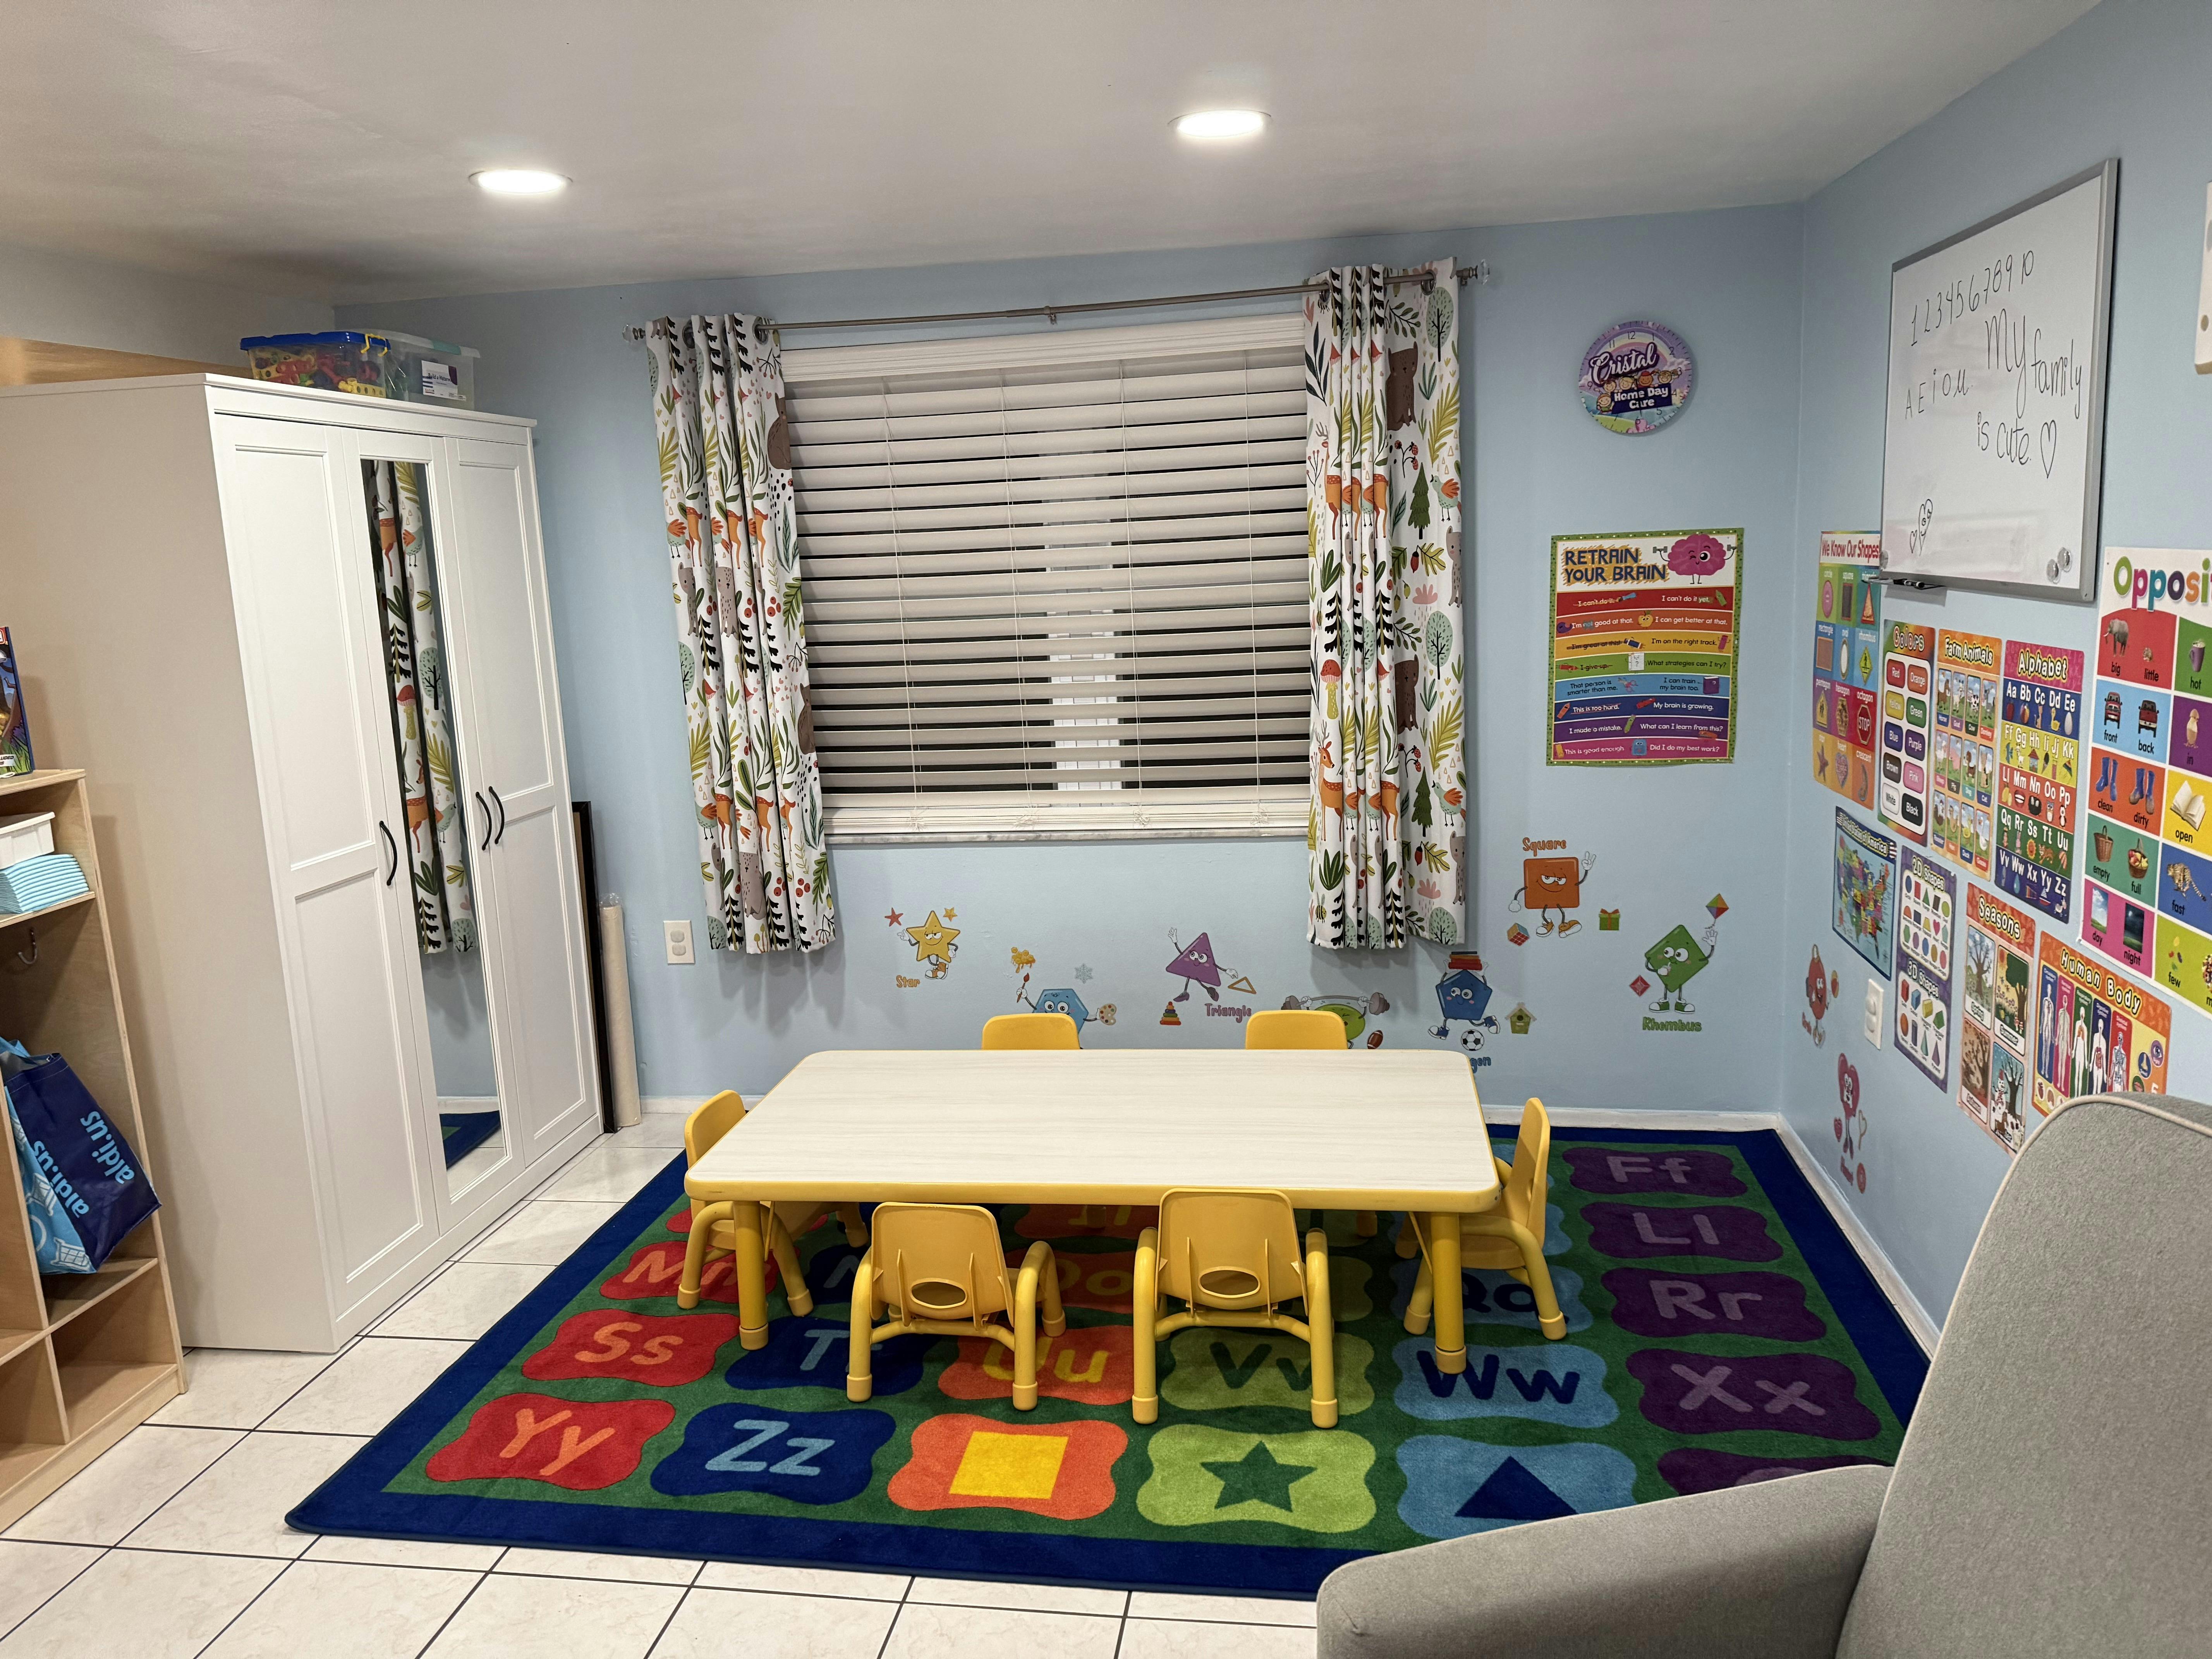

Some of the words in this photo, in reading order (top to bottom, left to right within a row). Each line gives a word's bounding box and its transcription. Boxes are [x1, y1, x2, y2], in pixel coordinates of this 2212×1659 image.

[1589, 343, 1658, 386] Cristal
[2032, 328, 2082, 419] family
[1614, 390, 1645, 401] Home
[1648, 387, 1668, 398] Day
[1629, 398, 1654, 409] Care
[1978, 411, 1989, 451] is
[1566, 548, 1638, 565] RETRAIN
[1822, 540, 1830, 556] We
[1831, 540, 1846, 557] Know
[1847, 539, 1857, 557] Our
[1565, 567, 1607, 583] YOUR
[1613, 565, 1666, 581] BRAIN
[2114, 556, 2212, 612] Opposi
[1893, 625, 1924, 651] Colors
[1945, 637, 1962, 659] Farm
[1963, 642, 1993, 666] Animals
[2018, 650, 2067, 680] Alphabet
[2111, 661, 2121, 676] big
[2144, 668, 2159, 682] little
[1910, 672, 1925, 687] Orange
[2190, 677, 2202, 690] hot
[2006, 681, 2016, 699] Aa
[2020, 684, 2031, 702] Bb
[2035, 687, 2045, 705] Cc
[2049, 690, 2061, 709] Dd
[2064, 694, 2076, 713] Ee
[1859, 717, 1870, 732] STOP
[1910, 705, 1923, 718] Green
[1889, 730, 1898, 742] Blue
[1909, 737, 1922, 752] Purple
[2005, 724, 2013, 740] Ff
[2015, 727, 2027, 748] Gg
[2029, 731, 2040, 749] Hh
[2063, 741, 2074, 759] Kk
[2104, 729, 2118, 743] front
[2138, 739, 2154, 754] back
[2187, 753, 2193, 766] in
[2014, 770, 2027, 789] Mm
[2030, 776, 2040, 794] Nn
[2044, 781, 2056, 800] Oo
[2059, 786, 2070, 809] Pp
[1906, 802, 1918, 817] Black
[2098, 799, 2113, 813] clean
[2134, 812, 2149, 828] dirty
[2001, 808, 2011, 830] Qq
[2015, 814, 2025, 832] Rr
[2028, 820, 2038, 838] Ss
[2042, 825, 2052, 845] Tt
[2057, 831, 2068, 852] Uu
[2175, 830, 2193, 843] open
[1523, 837, 1566, 857] Square
[1912, 857, 1922, 878] 2D
[2000, 849, 2009, 868] Vv
[2012, 855, 2025, 876] Ww
[2027, 863, 2037, 883] Xx
[2041, 869, 2052, 893] Yy
[2055, 876, 2066, 897] Zz
[2093, 865, 2110, 882] empty
[2131, 881, 2142, 895] full
[1978, 896, 2021, 940] Seasons
[2172, 899, 2185, 915] fast
[2092, 931, 2103, 946] day
[2124, 950, 2141, 966] night
[896, 975, 920, 988] Star
[1908, 960, 1917, 980] 3D
[2061, 948, 2101, 989] Human
[2107, 977, 2141, 1015] Body
[2168, 971, 2181, 988] few
[1204, 1003, 1252, 1023] Triangle
[1642, 1017, 1702, 1032] Rhombus
[80, 1111, 135, 1184] aldi.us
[33, 1140, 89, 1218] aldi.us
[1607, 1156, 1692, 1183] Ff
[1649, 1280, 1763, 1320] Rr
[574, 1321, 684, 1365] Ss
[1209, 1341, 1313, 1391] Vv
[1416, 1350, 1580, 1404] Ww
[1671, 1364, 1826, 1416] Xx
[499, 1408, 615, 1477] Yy
[705, 1419, 835, 1477] Zz
